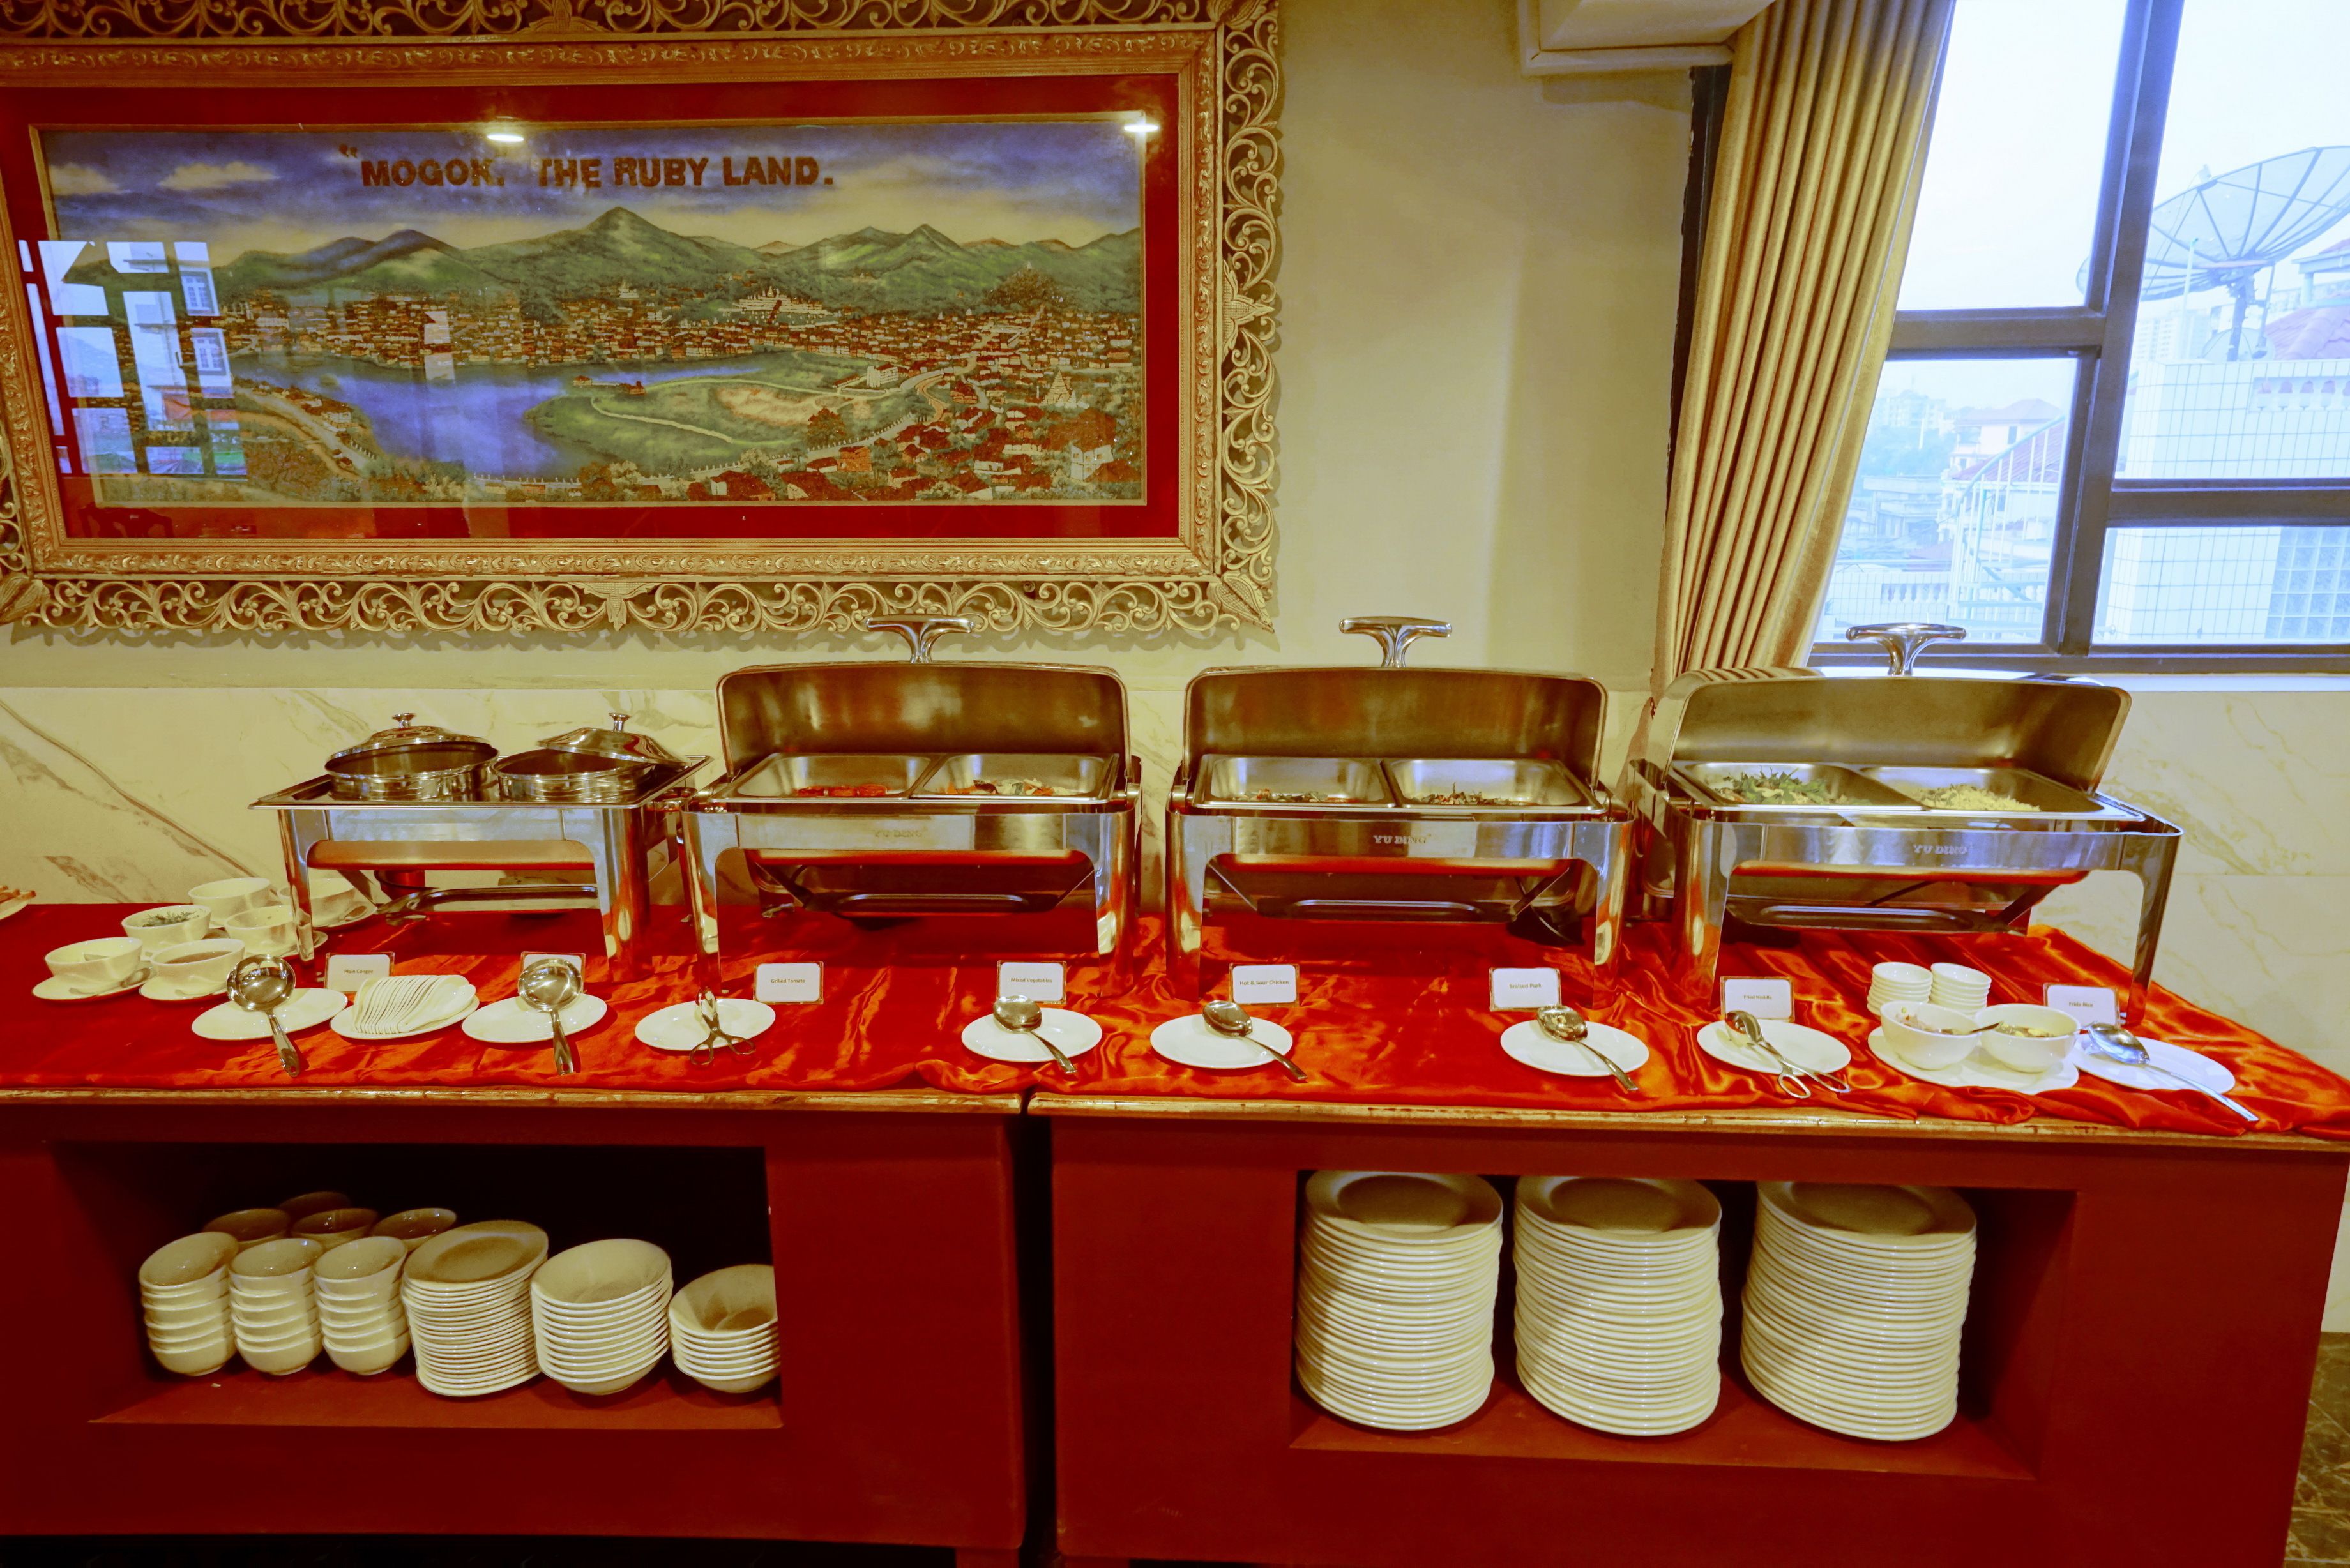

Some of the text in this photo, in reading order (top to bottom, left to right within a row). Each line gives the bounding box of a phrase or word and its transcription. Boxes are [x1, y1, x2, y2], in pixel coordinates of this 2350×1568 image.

[538, 158, 602, 188] THE
[613, 157, 709, 187] RUBY
[722, 156, 833, 186] LAND.
[1373, 835, 1426, 845] YU DING
[1913, 845, 1967, 854] YU DING
